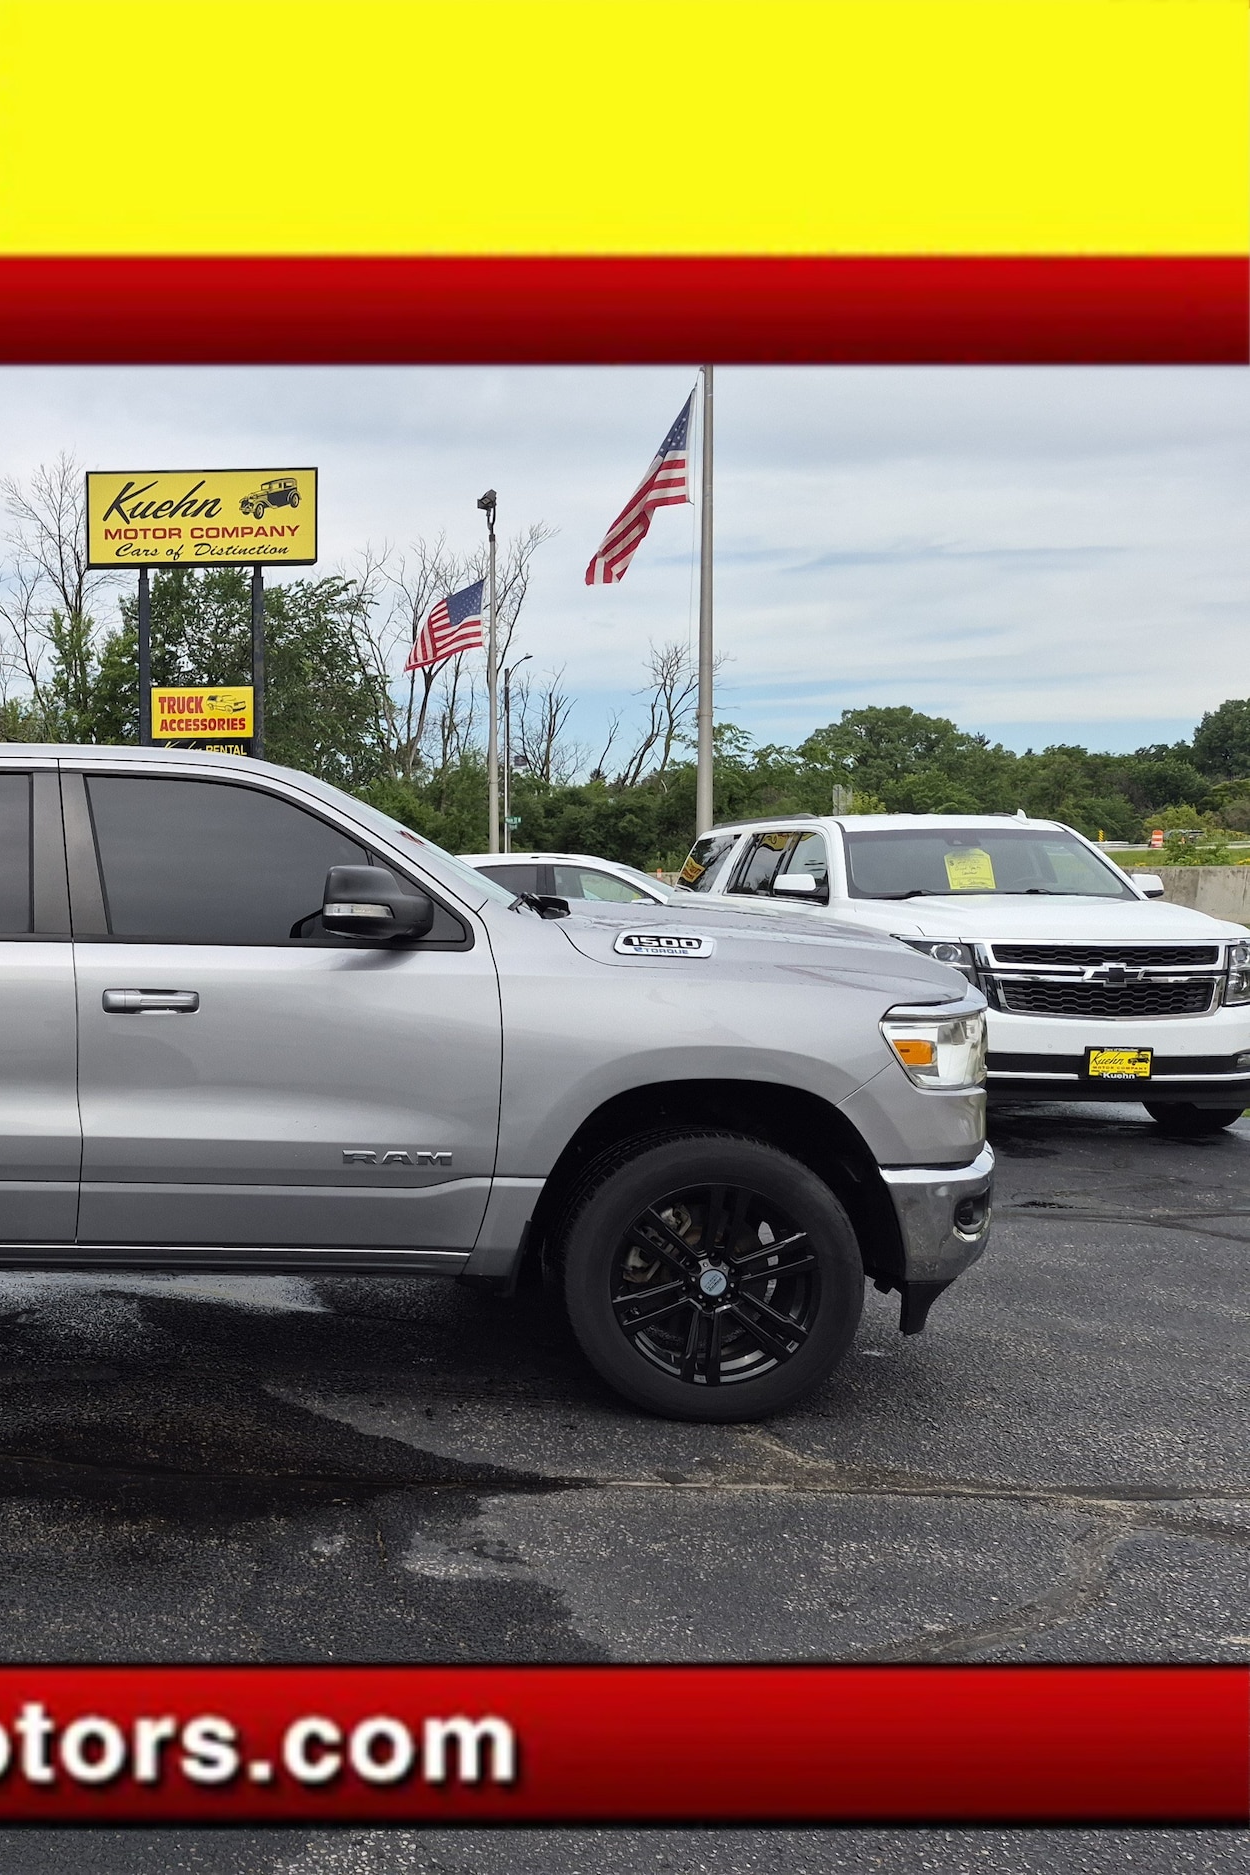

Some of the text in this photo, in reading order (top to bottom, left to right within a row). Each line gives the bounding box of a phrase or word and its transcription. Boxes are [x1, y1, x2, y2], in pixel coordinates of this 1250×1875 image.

[102, 480, 222, 524] Kuehn
[104, 525, 300, 540] MOTOR COMPANY
[115, 542, 289, 560] Cars of Distinction
[158, 696, 204, 714] TRUCK
[159, 717, 246, 732] ACCESSORIES
[205, 744, 248, 756] RENTAL
[631, 936, 700, 949] 1500
[1091, 1052, 1125, 1065] Kuehn
[342, 1149, 453, 1167] RAM
